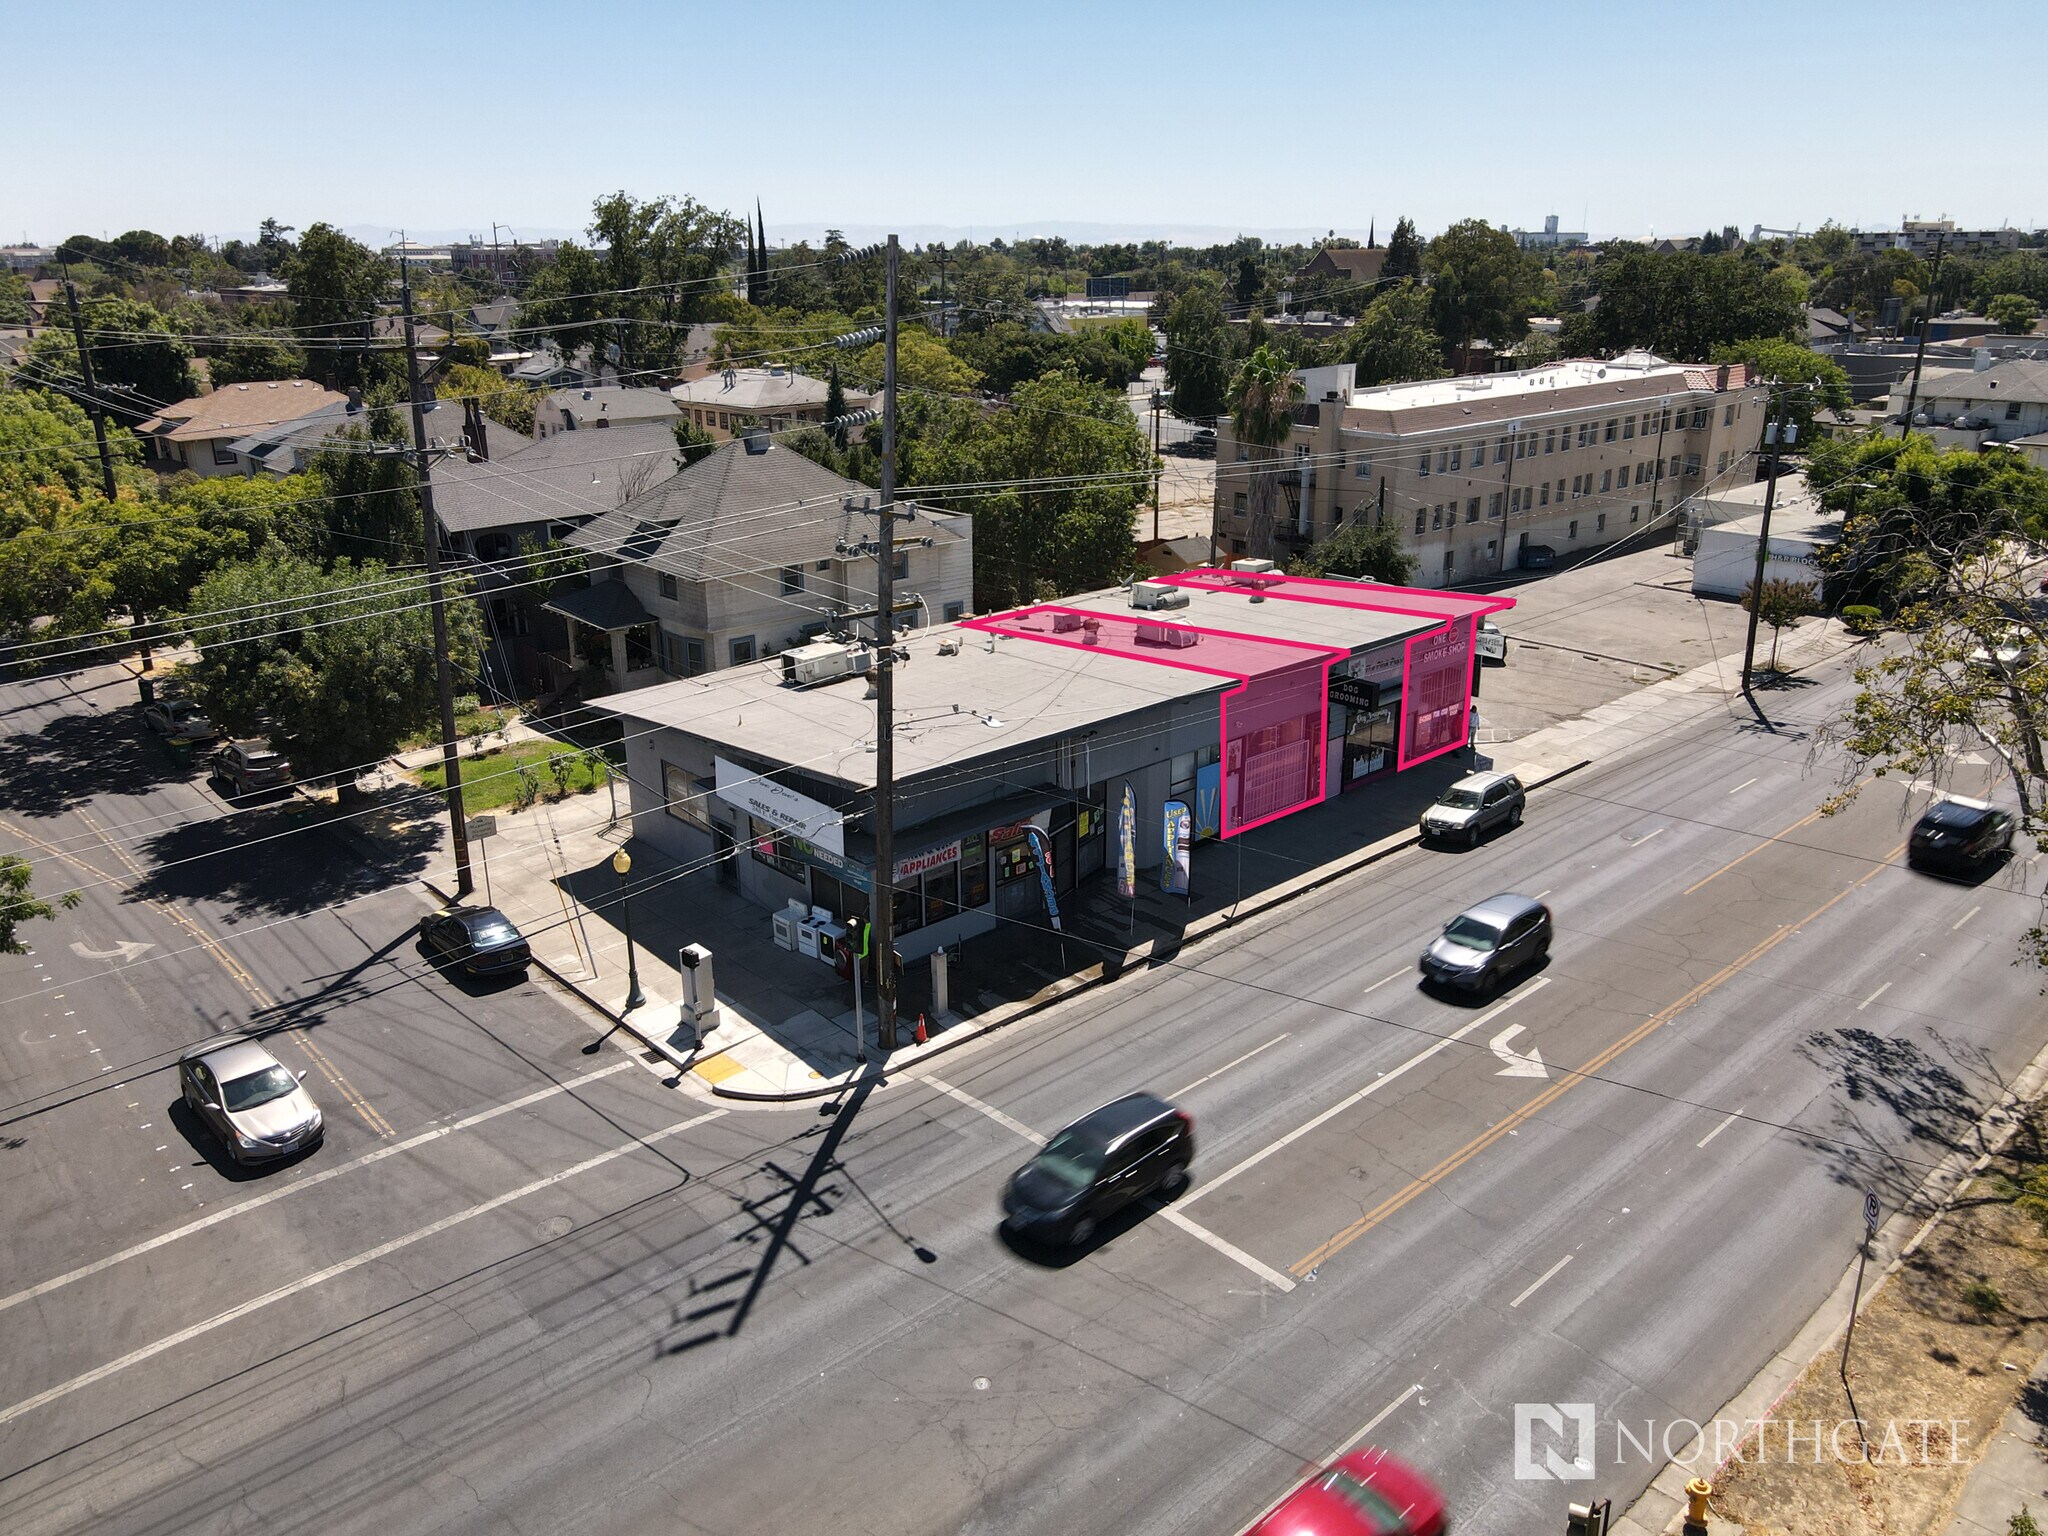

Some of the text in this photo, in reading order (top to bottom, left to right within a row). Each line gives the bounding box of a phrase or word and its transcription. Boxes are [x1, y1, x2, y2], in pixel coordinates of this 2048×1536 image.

[1772, 554, 1819, 566] H&R BLOCK
[1433, 633, 1447, 645] ONE
[1423, 646, 1448, 663] SMOKE
[1449, 641, 1466, 656] SHOP
[1343, 684, 1359, 694] DOG
[1329, 690, 1369, 707] GROOMING
[748, 798, 807, 830] SALES & REPAIR
[1166, 807, 1187, 819] USED
[813, 847, 844, 869] NEEDED
[902, 846, 958, 876] APPLIANCES
